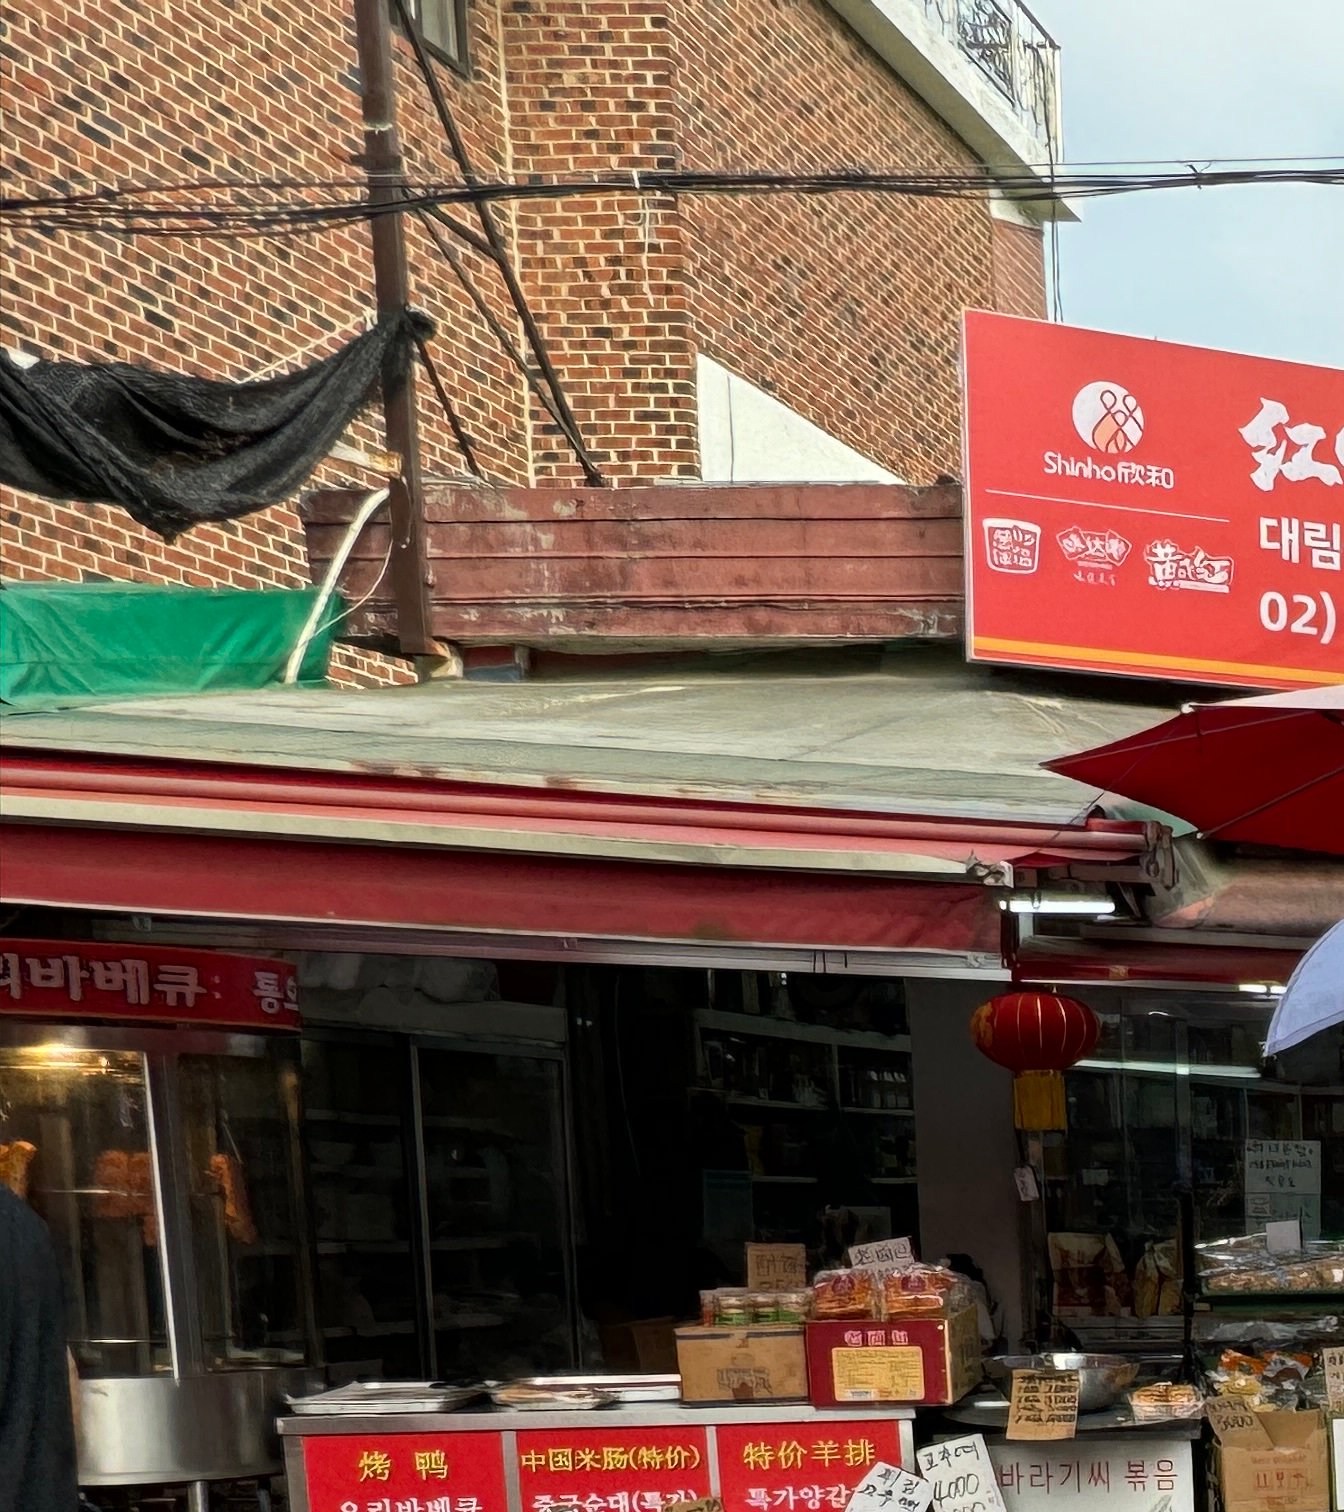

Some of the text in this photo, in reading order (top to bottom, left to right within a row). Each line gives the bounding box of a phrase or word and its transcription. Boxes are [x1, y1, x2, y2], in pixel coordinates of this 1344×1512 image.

[1043, 450, 1175, 489] Shinho 欣和
[1259, 590, 1337, 644] 02)
[521, 1444, 701, 1473] 中国米肠(特价)
[743, 1438, 876, 1471] 特价羊排
[1124, 1458, 1179, 1492] 볶음
[746, 1483, 858, 1511] 특가양갈
